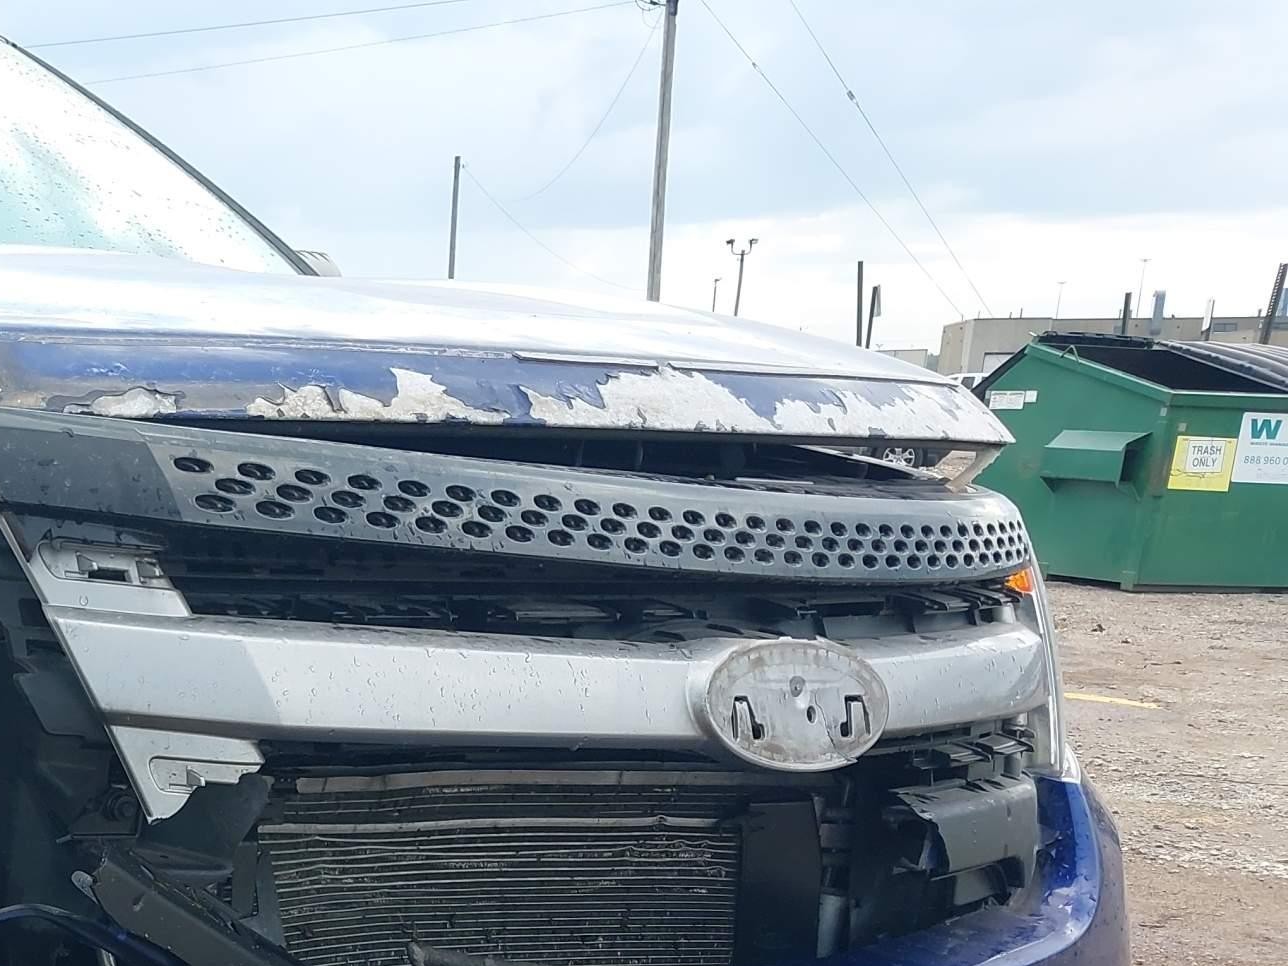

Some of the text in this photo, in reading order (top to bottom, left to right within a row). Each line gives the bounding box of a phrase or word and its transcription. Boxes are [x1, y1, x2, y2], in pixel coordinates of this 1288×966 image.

[1192, 445, 1222, 456] TRASH
[1192, 457, 1218, 468] ONLY
[1243, 455, 1261, 465] 888
[1263, 456, 1281, 465] 960
